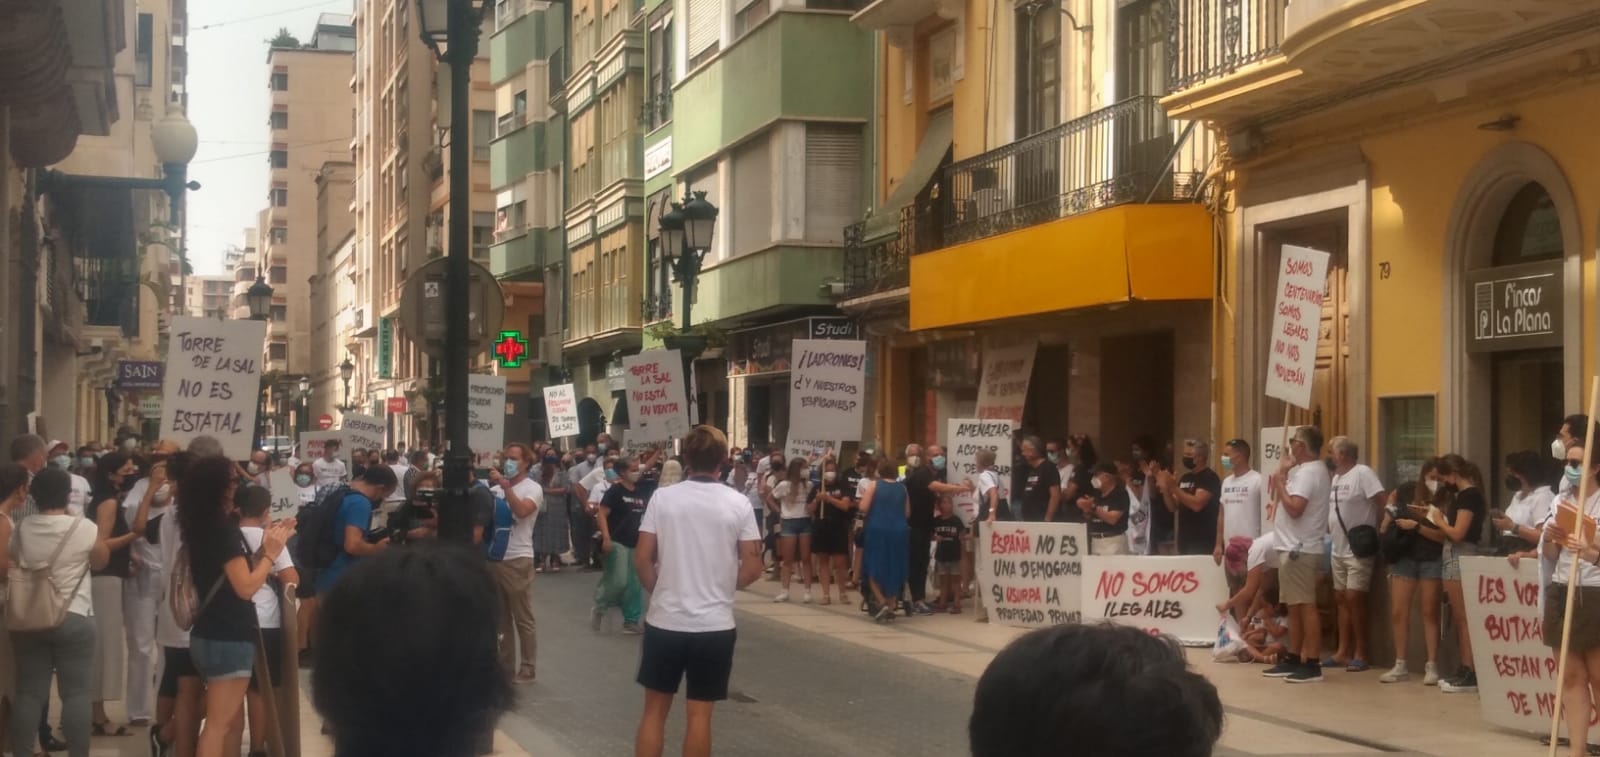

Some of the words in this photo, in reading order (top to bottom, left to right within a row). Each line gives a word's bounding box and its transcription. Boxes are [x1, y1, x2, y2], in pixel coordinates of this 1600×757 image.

[1286, 258, 1313, 277] SOMOS
[1379, 261, 1391, 280] 79
[1505, 282, 1541, 309] Fincas
[1279, 302, 1301, 321] SOMOS
[1496, 309, 1511, 334] La
[1514, 307, 1551, 333] Plana
[1283, 322, 1309, 341] LEGALES
[177, 331, 224, 353] TORRE
[1275, 339, 1285, 354] NO
[191, 354, 211, 369] DE
[215, 356, 231, 371] LA
[232, 357, 255, 374] SAL
[629, 362, 660, 376] TORRE
[640, 375, 651, 385] LA
[653, 371, 672, 385] SAL
[1275, 363, 1305, 386] MOVERÁN
[178, 378, 202, 398] NO
[209, 380, 233, 400] ES
[644, 386, 667, 401] ESTÁ
[812, 379, 858, 395] NUESTROS
[640, 404, 651, 416] EN
[653, 402, 679, 415] VENTA
[801, 395, 857, 412] ESPIGONES?
[172, 409, 242, 434] ESTATAL
[956, 423, 1013, 440] AMENAZAR,
[952, 461, 960, 473] Y
[991, 529, 1031, 554] ESPAÑA
[1035, 535, 1055, 555] NO
[1059, 535, 1079, 556] ES
[993, 560, 1016, 577] UNA
[1095, 571, 1125, 600] NO
[1132, 570, 1199, 597] SOMOS
[1478, 574, 1506, 603] LES
[1006, 587, 1041, 603] USURPA
[1046, 586, 1060, 606] LA
[996, 607, 1044, 623] PROPIEDAD
[1104, 600, 1183, 619] ILEGALES
[1485, 614, 1544, 644] BUTXA
[1493, 654, 1541, 679] ESTAN
[1507, 691, 1532, 716] DE
